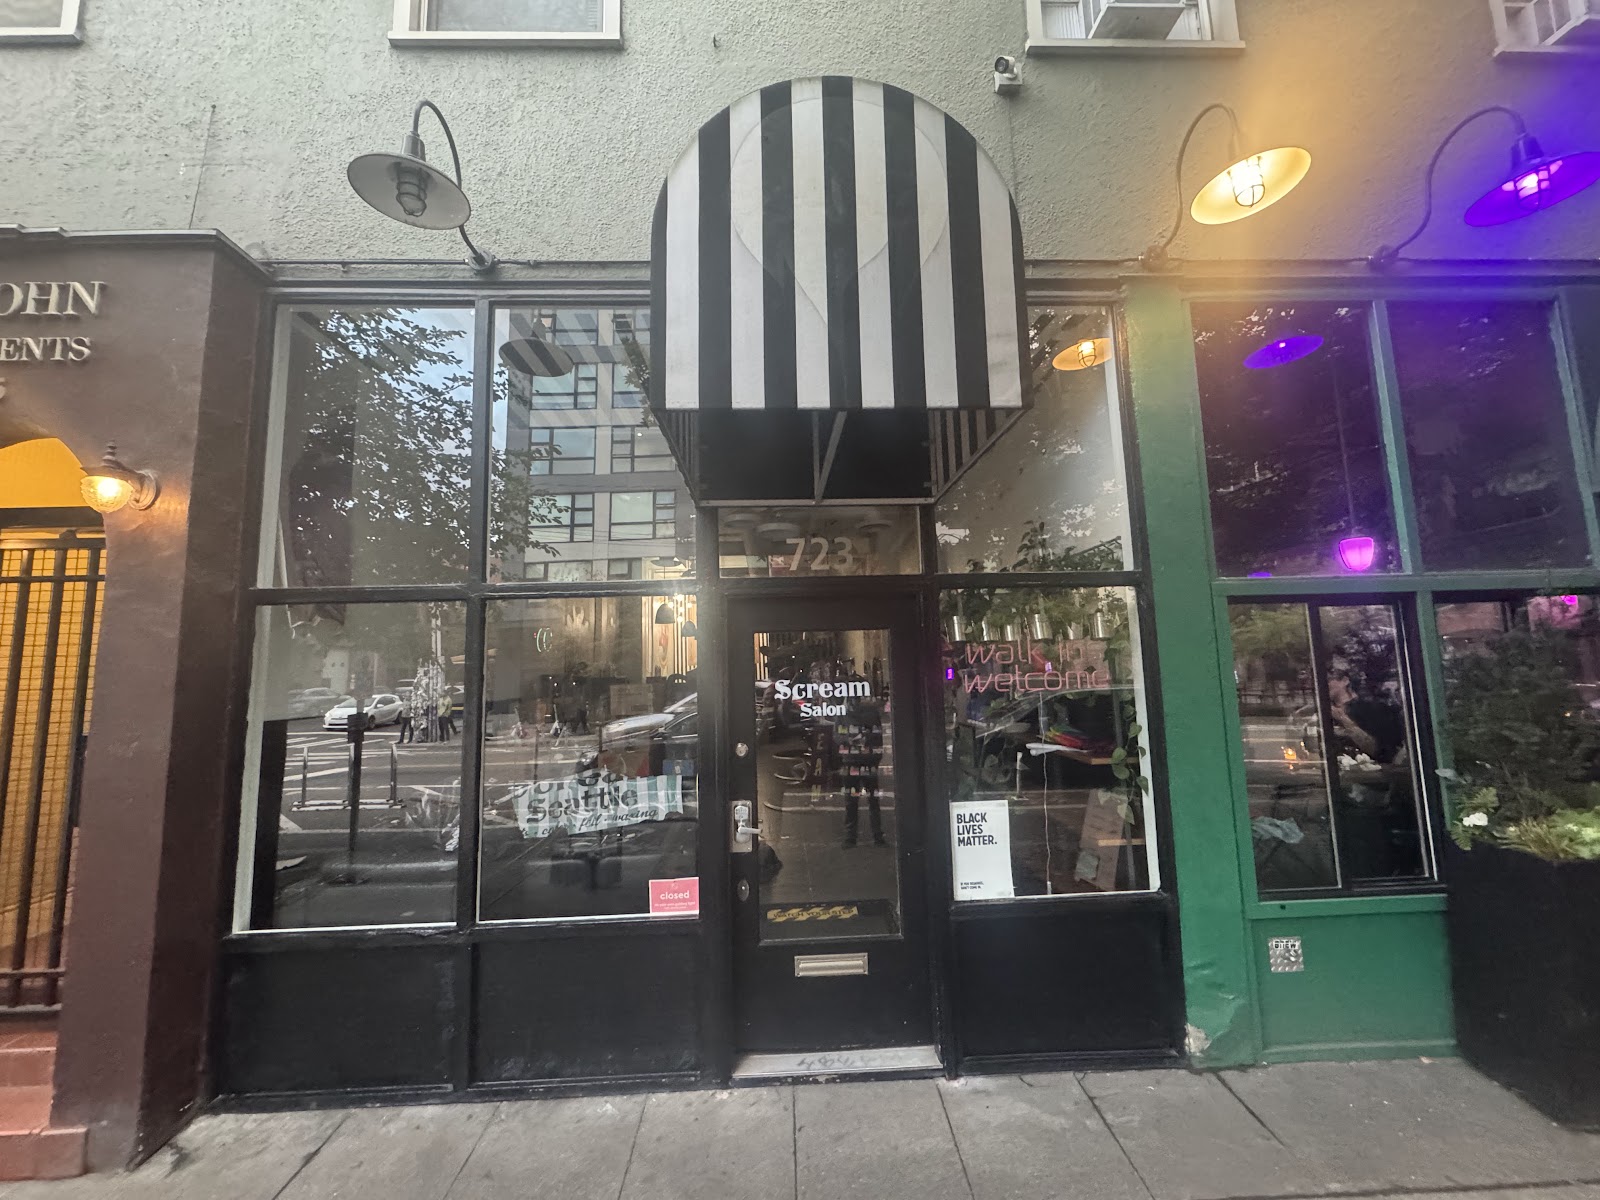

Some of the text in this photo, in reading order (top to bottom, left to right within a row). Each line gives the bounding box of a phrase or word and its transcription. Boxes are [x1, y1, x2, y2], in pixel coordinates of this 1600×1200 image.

[785, 537, 853, 571] 723
[966, 638, 1045, 665] walk
[964, 665, 1110, 694] welcome
[774, 678, 871, 701] Scream
[800, 702, 847, 718] Salon
[527, 786, 638, 824] Seattle
[956, 812, 987, 824] BLACK
[957, 824, 983, 835] LIVES
[957, 835, 998, 847] MATTER.
[660, 890, 690, 900] closed
[773, 911, 804, 919] WATCH
[806, 909, 832, 918] YOUR
